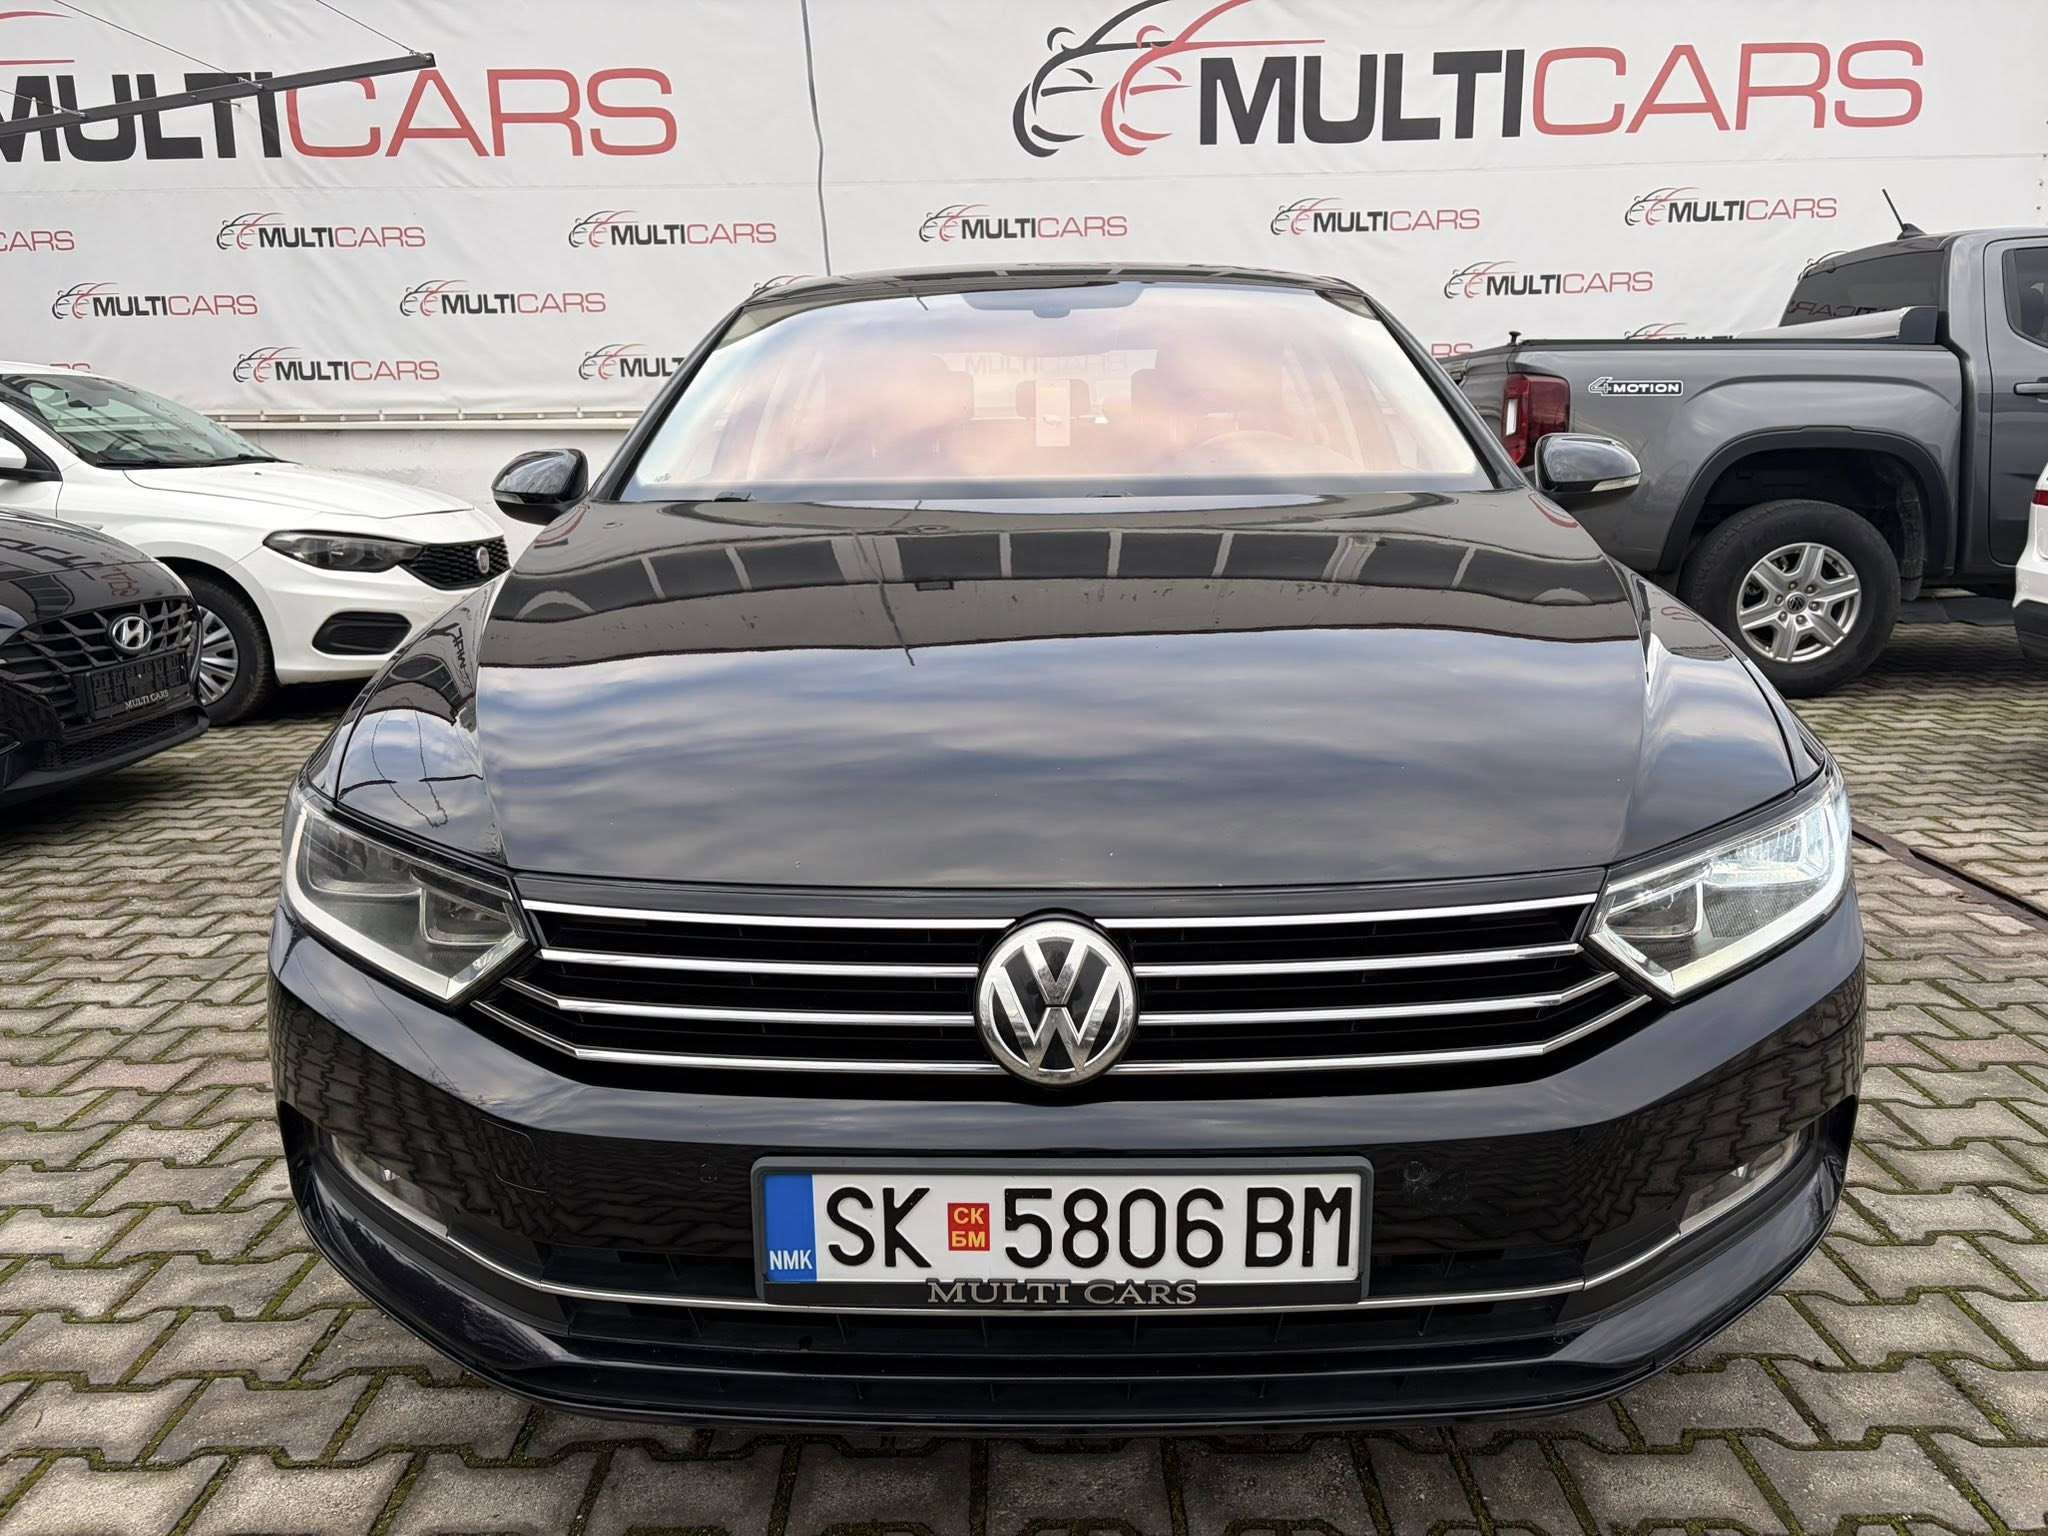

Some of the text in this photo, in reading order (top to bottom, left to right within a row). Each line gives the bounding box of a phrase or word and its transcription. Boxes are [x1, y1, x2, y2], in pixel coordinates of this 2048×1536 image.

[1200, 39, 1924, 145] MULTICARS
[1313, 208, 1480, 233] MULTICARS
[1667, 197, 1838, 223] MULTICARS
[258, 226, 426, 248] MULTICARS
[611, 222, 777, 246] MULTICARS
[961, 215, 1128, 239] MULTICARS
[1486, 271, 1654, 296] MULTICARS
[93, 294, 258, 318] MULTICARS
[441, 292, 607, 315] MULTICARS
[275, 360, 441, 382] MULTICARS
[1588, 376, 1684, 396] 4MOTION
[826, 1186, 1353, 1268] SK 5806 BM
[769, 1249, 813, 1271] NMK
[926, 1279, 1198, 1305] MULTI CARS
